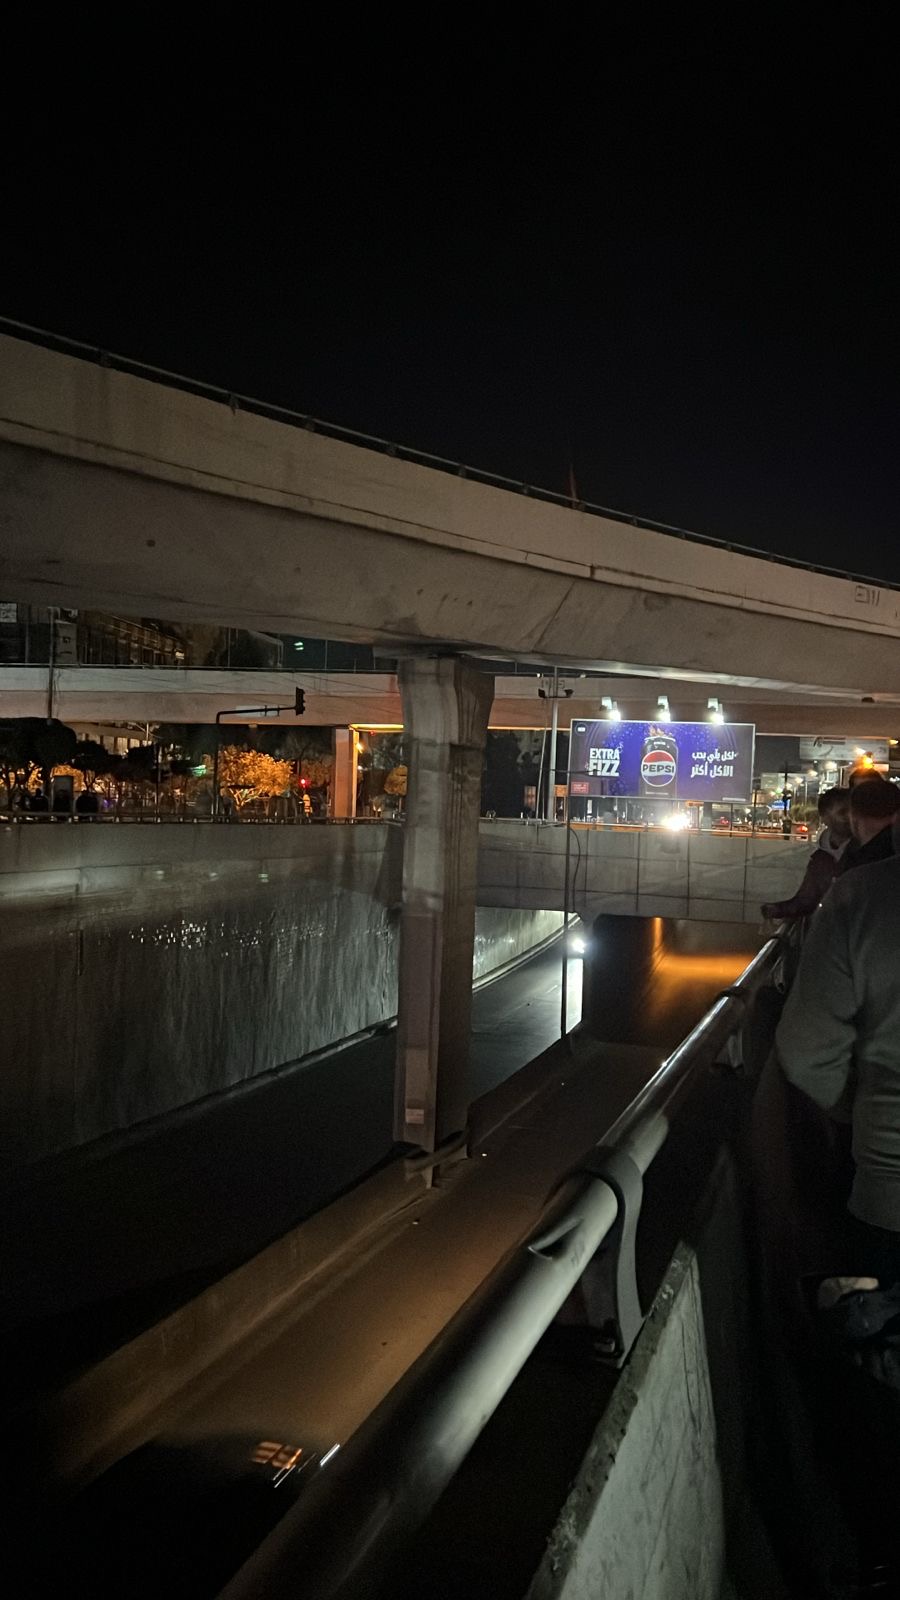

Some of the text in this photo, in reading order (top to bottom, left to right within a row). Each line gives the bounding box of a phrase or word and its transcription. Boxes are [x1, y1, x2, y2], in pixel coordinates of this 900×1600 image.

[589, 748, 620, 760] EXTRA
[721, 750, 735, 762] لكل
[589, 759, 620, 777] FIZZ
[643, 764, 675, 773] PEPSI
